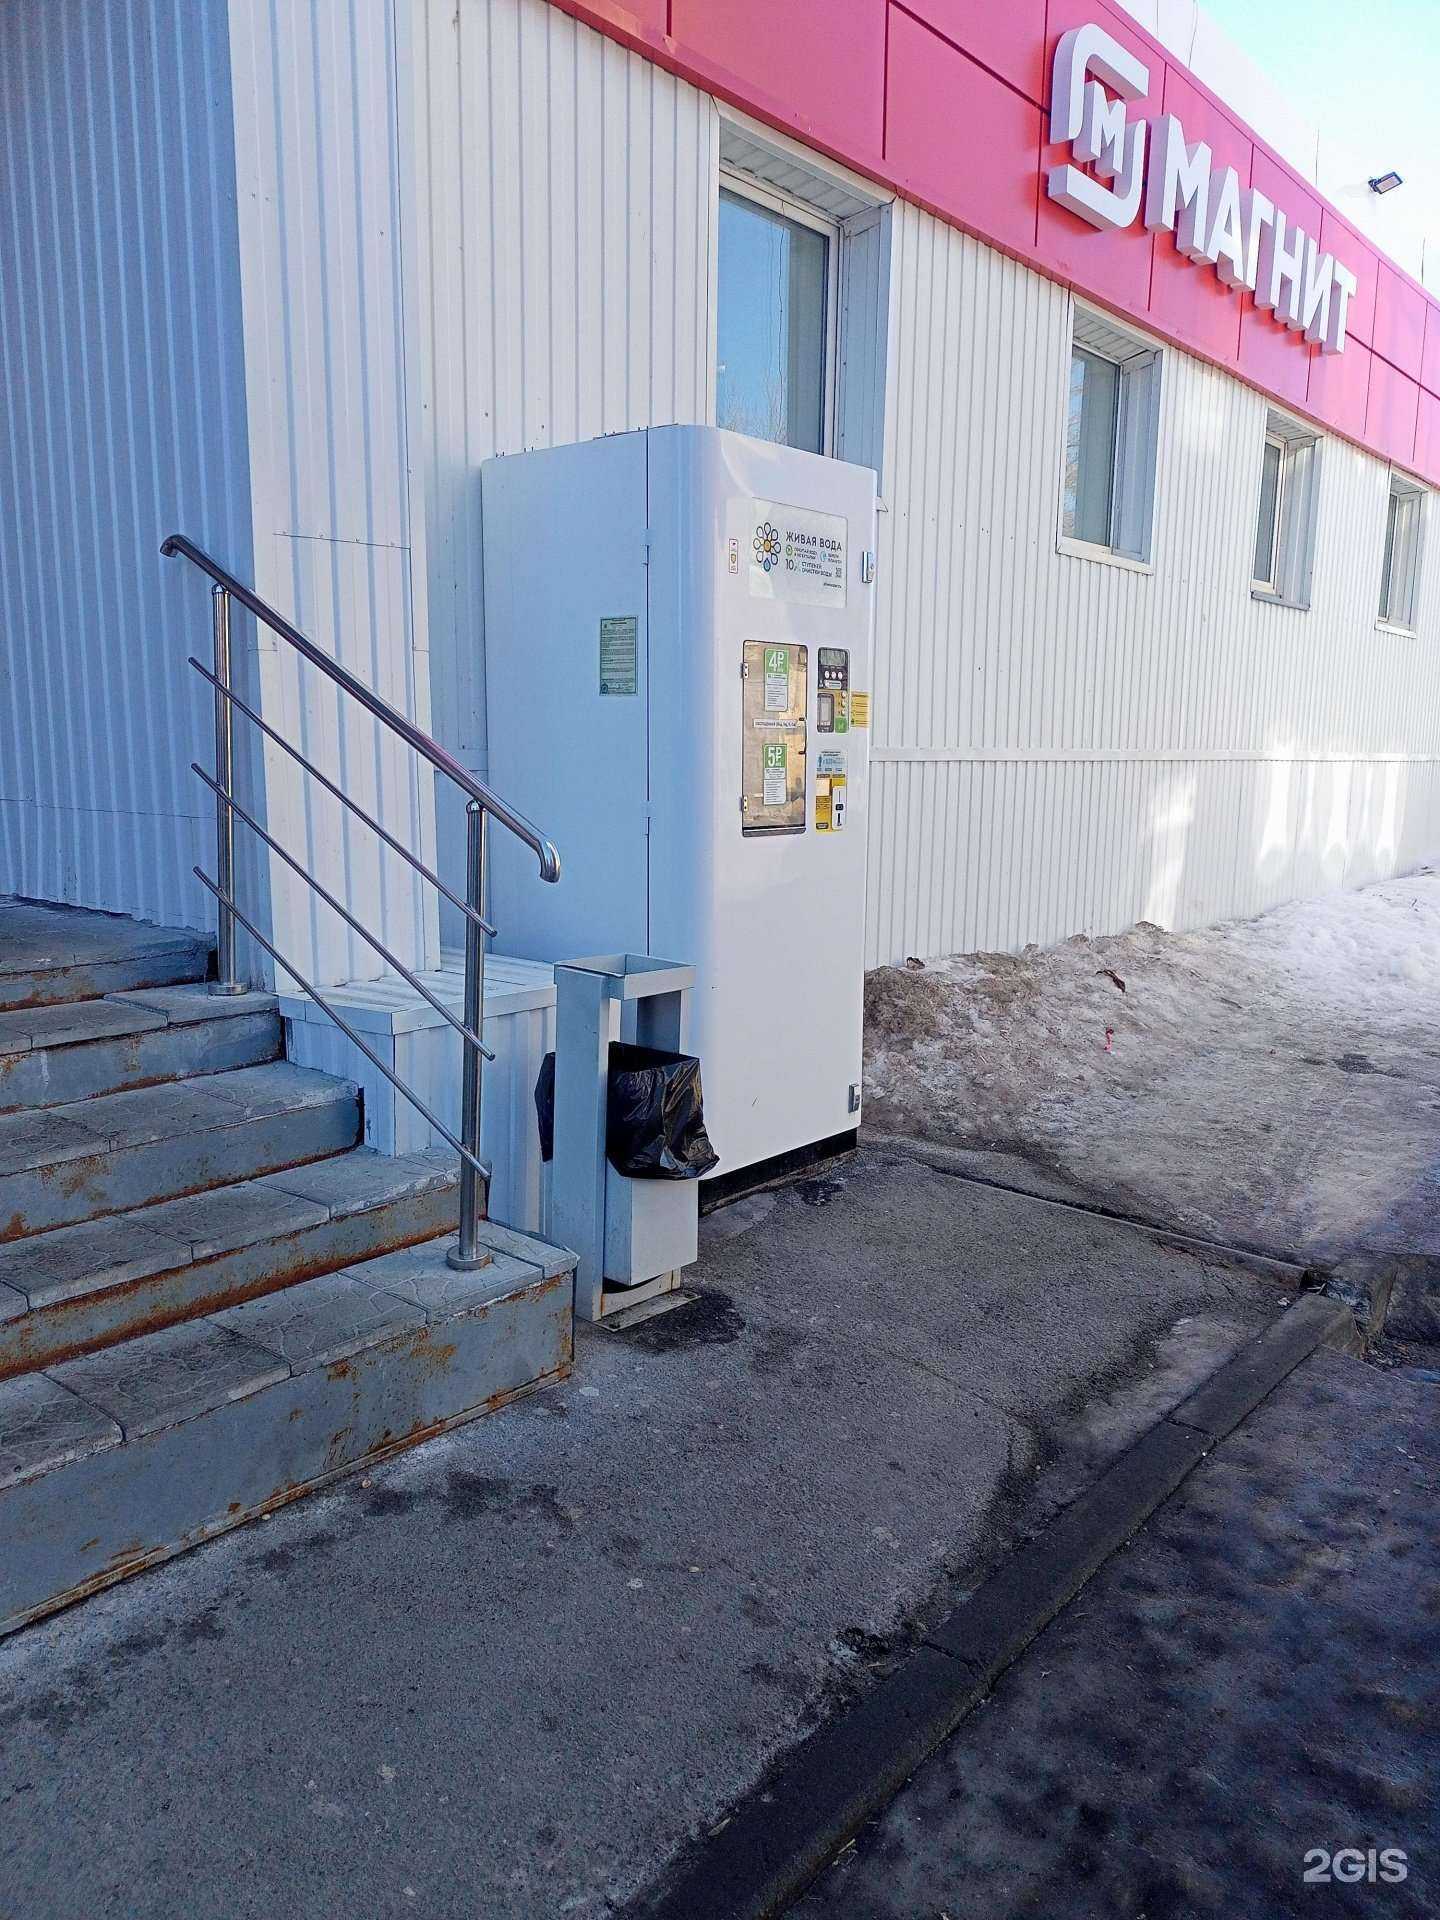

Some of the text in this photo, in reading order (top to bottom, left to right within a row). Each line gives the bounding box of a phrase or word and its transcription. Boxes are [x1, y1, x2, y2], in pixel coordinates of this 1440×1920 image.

[1146, 113, 1357, 354] МАГНИТ
[786, 531, 817, 547] ЖИВАЯ
[819, 537, 842, 552] ВОДА
